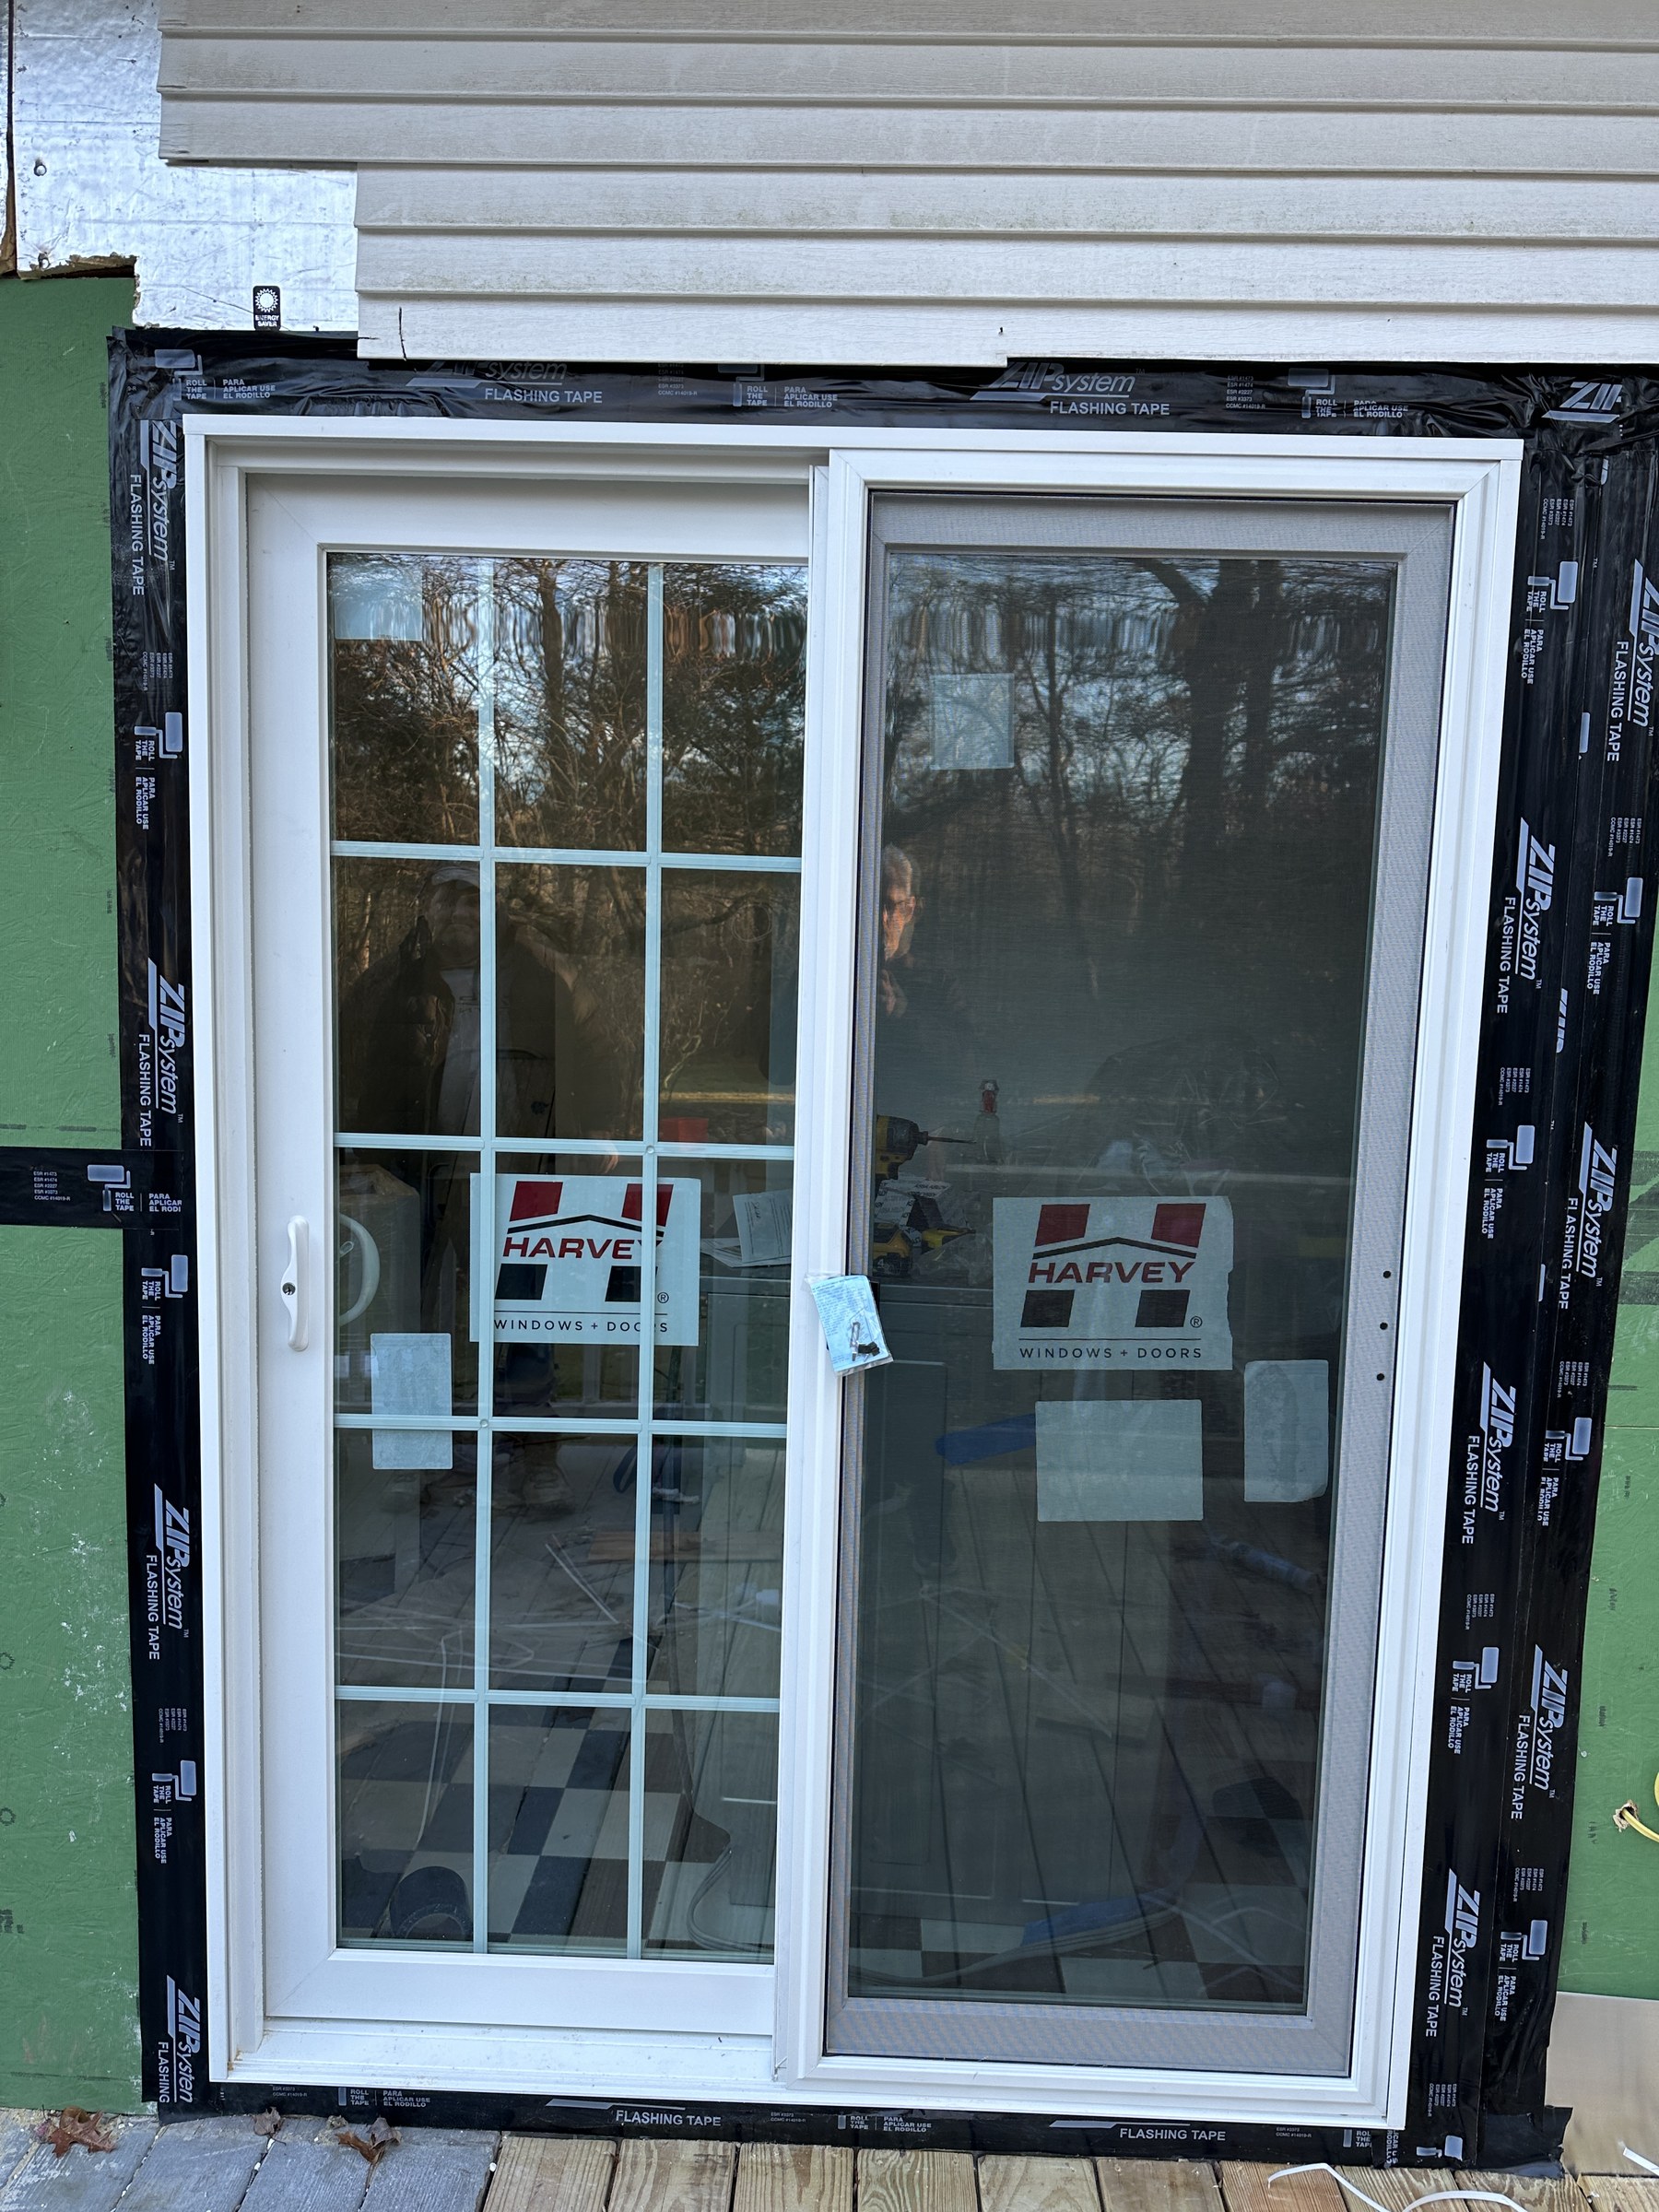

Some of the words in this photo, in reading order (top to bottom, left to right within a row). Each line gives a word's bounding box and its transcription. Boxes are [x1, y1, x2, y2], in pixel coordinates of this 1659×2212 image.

[485, 388, 559, 403] FLASHING
[564, 391, 603, 403] TAPE
[1051, 401, 1126, 414] FLASHING
[1131, 403, 1170, 415] TAPE
[130, 475, 143, 552] FLASHING
[132, 557, 144, 595] TAPE
[1524, 629, 1530, 640] EL
[1528, 629, 1537, 665] APLICAR
[1521, 642, 1529, 678] RODILLO
[1610, 641, 1629, 718] FLASHING
[1607, 722, 1622, 762] TAPE
[135, 777, 142, 787] EL
[1500, 897, 1516, 971] FLASHING
[1590, 942, 1597, 952] EL
[1587, 954, 1595, 989] RODILLO
[1595, 942, 1604, 977] APLICAR
[1497, 976, 1510, 1013] TAPE
[139, 1034, 151, 1106] FLASHING
[139, 1110, 151, 1147] TAPE
[1483, 1188, 1489, 1198] EL
[1488, 1188, 1497, 1222] APLICAR
[1028, 1262, 1195, 1283] HARVEY
[142, 1315, 148, 1325] EL
[494, 1320, 582, 1331] WINDOWS
[607, 1322, 668, 1332] DOOS
[1020, 1348, 1112, 1358] WINDOWS
[1138, 1348, 1201, 1358] DOORS
[1464, 1435, 1480, 1505] FLASHING
[1462, 1508, 1475, 1544] TAPE
[146, 1554, 158, 1621] FLASHING
[148, 1626, 159, 1659] TAPE
[1450, 1706, 1457, 1715] EL
[1455, 1707, 1464, 1737] APLICAR
[1448, 1717, 1456, 1748] RODILLO
[1514, 1715, 1530, 1782] FLASHING
[1511, 1785, 1525, 1819] TAPE
[154, 1817, 160, 1826] EL
[1429, 1936, 1444, 2001] FLASHING
[1498, 1975, 1504, 1985] EL
[1501, 1975, 1510, 2005] APLICAR
[1426, 2005, 1439, 2037] TAPE
[158, 2041, 170, 2103] FLASHING
[615, 2110, 683, 2125] FLASHING
[686, 2115, 721, 2127] TAPE
[1119, 2128, 1187, 2139] FLASHING
[1191, 2130, 1226, 2141] TAPE
